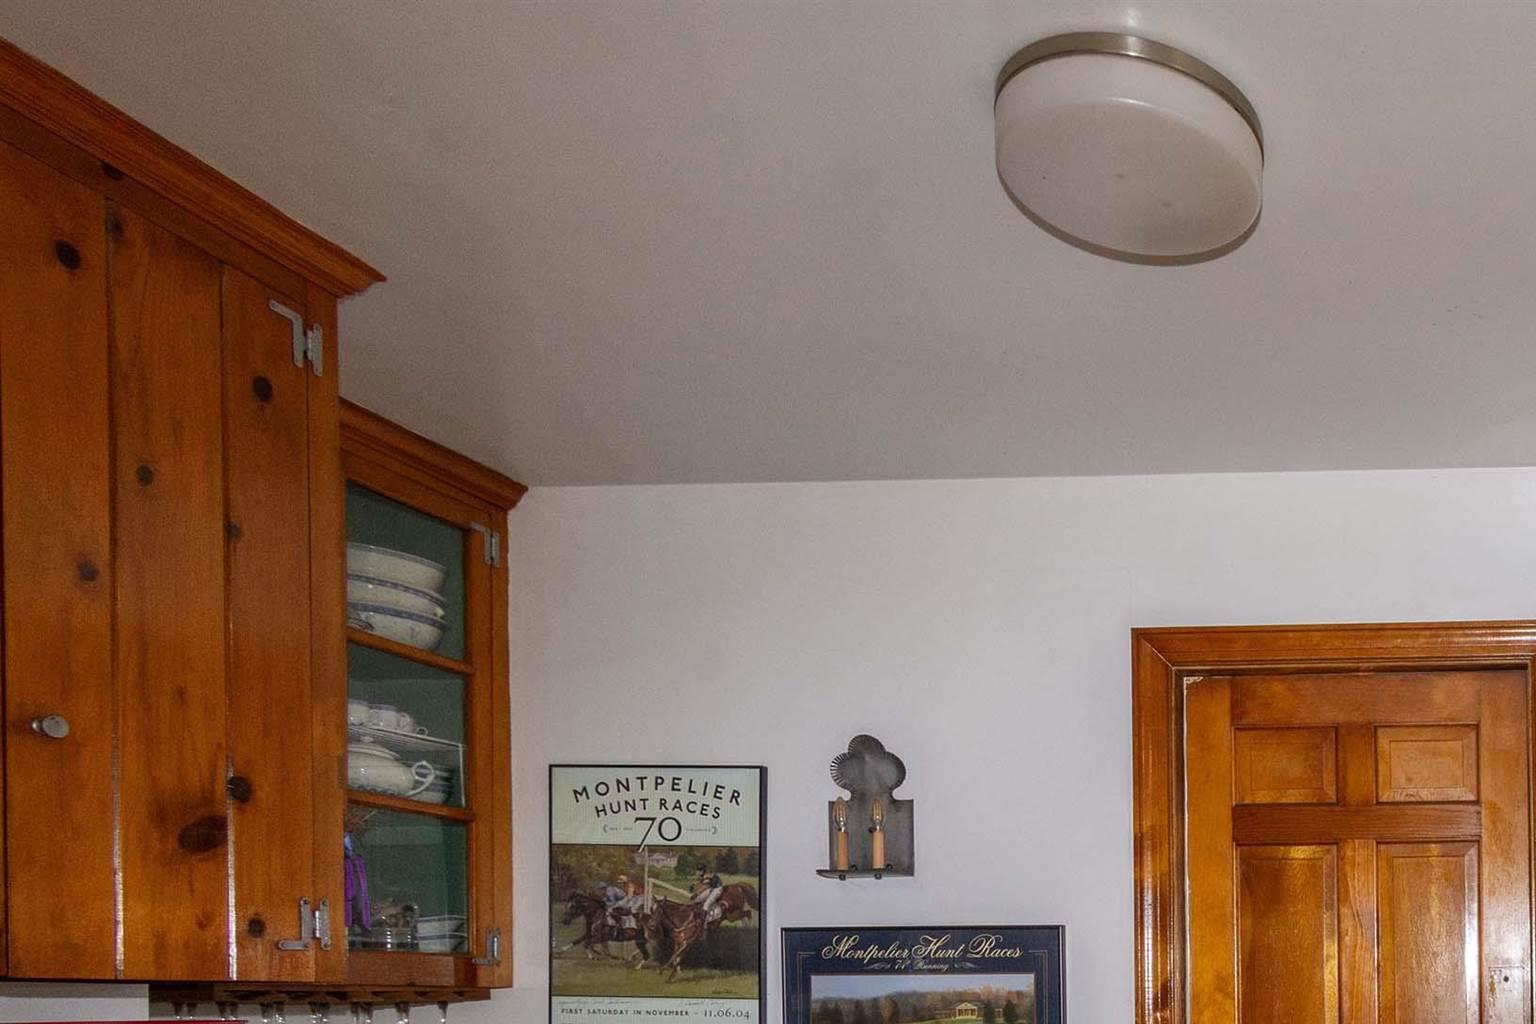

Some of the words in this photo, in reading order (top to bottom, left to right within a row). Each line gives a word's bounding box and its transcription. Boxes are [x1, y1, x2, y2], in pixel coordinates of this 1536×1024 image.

[572, 776, 741, 806] MONTPELIER
[594, 798, 649, 818] HUNT
[658, 798, 721, 819] RACES
[634, 816, 682, 853] 70
[822, 934, 910, 963] Montpelier
[912, 934, 965, 959] Hunt
[966, 933, 1024, 959] Races
[587, 1008, 629, 1016] SATURDAY
[646, 1009, 689, 1017] NOVEMBER
[704, 1008, 750, 1020] 11.06.04
